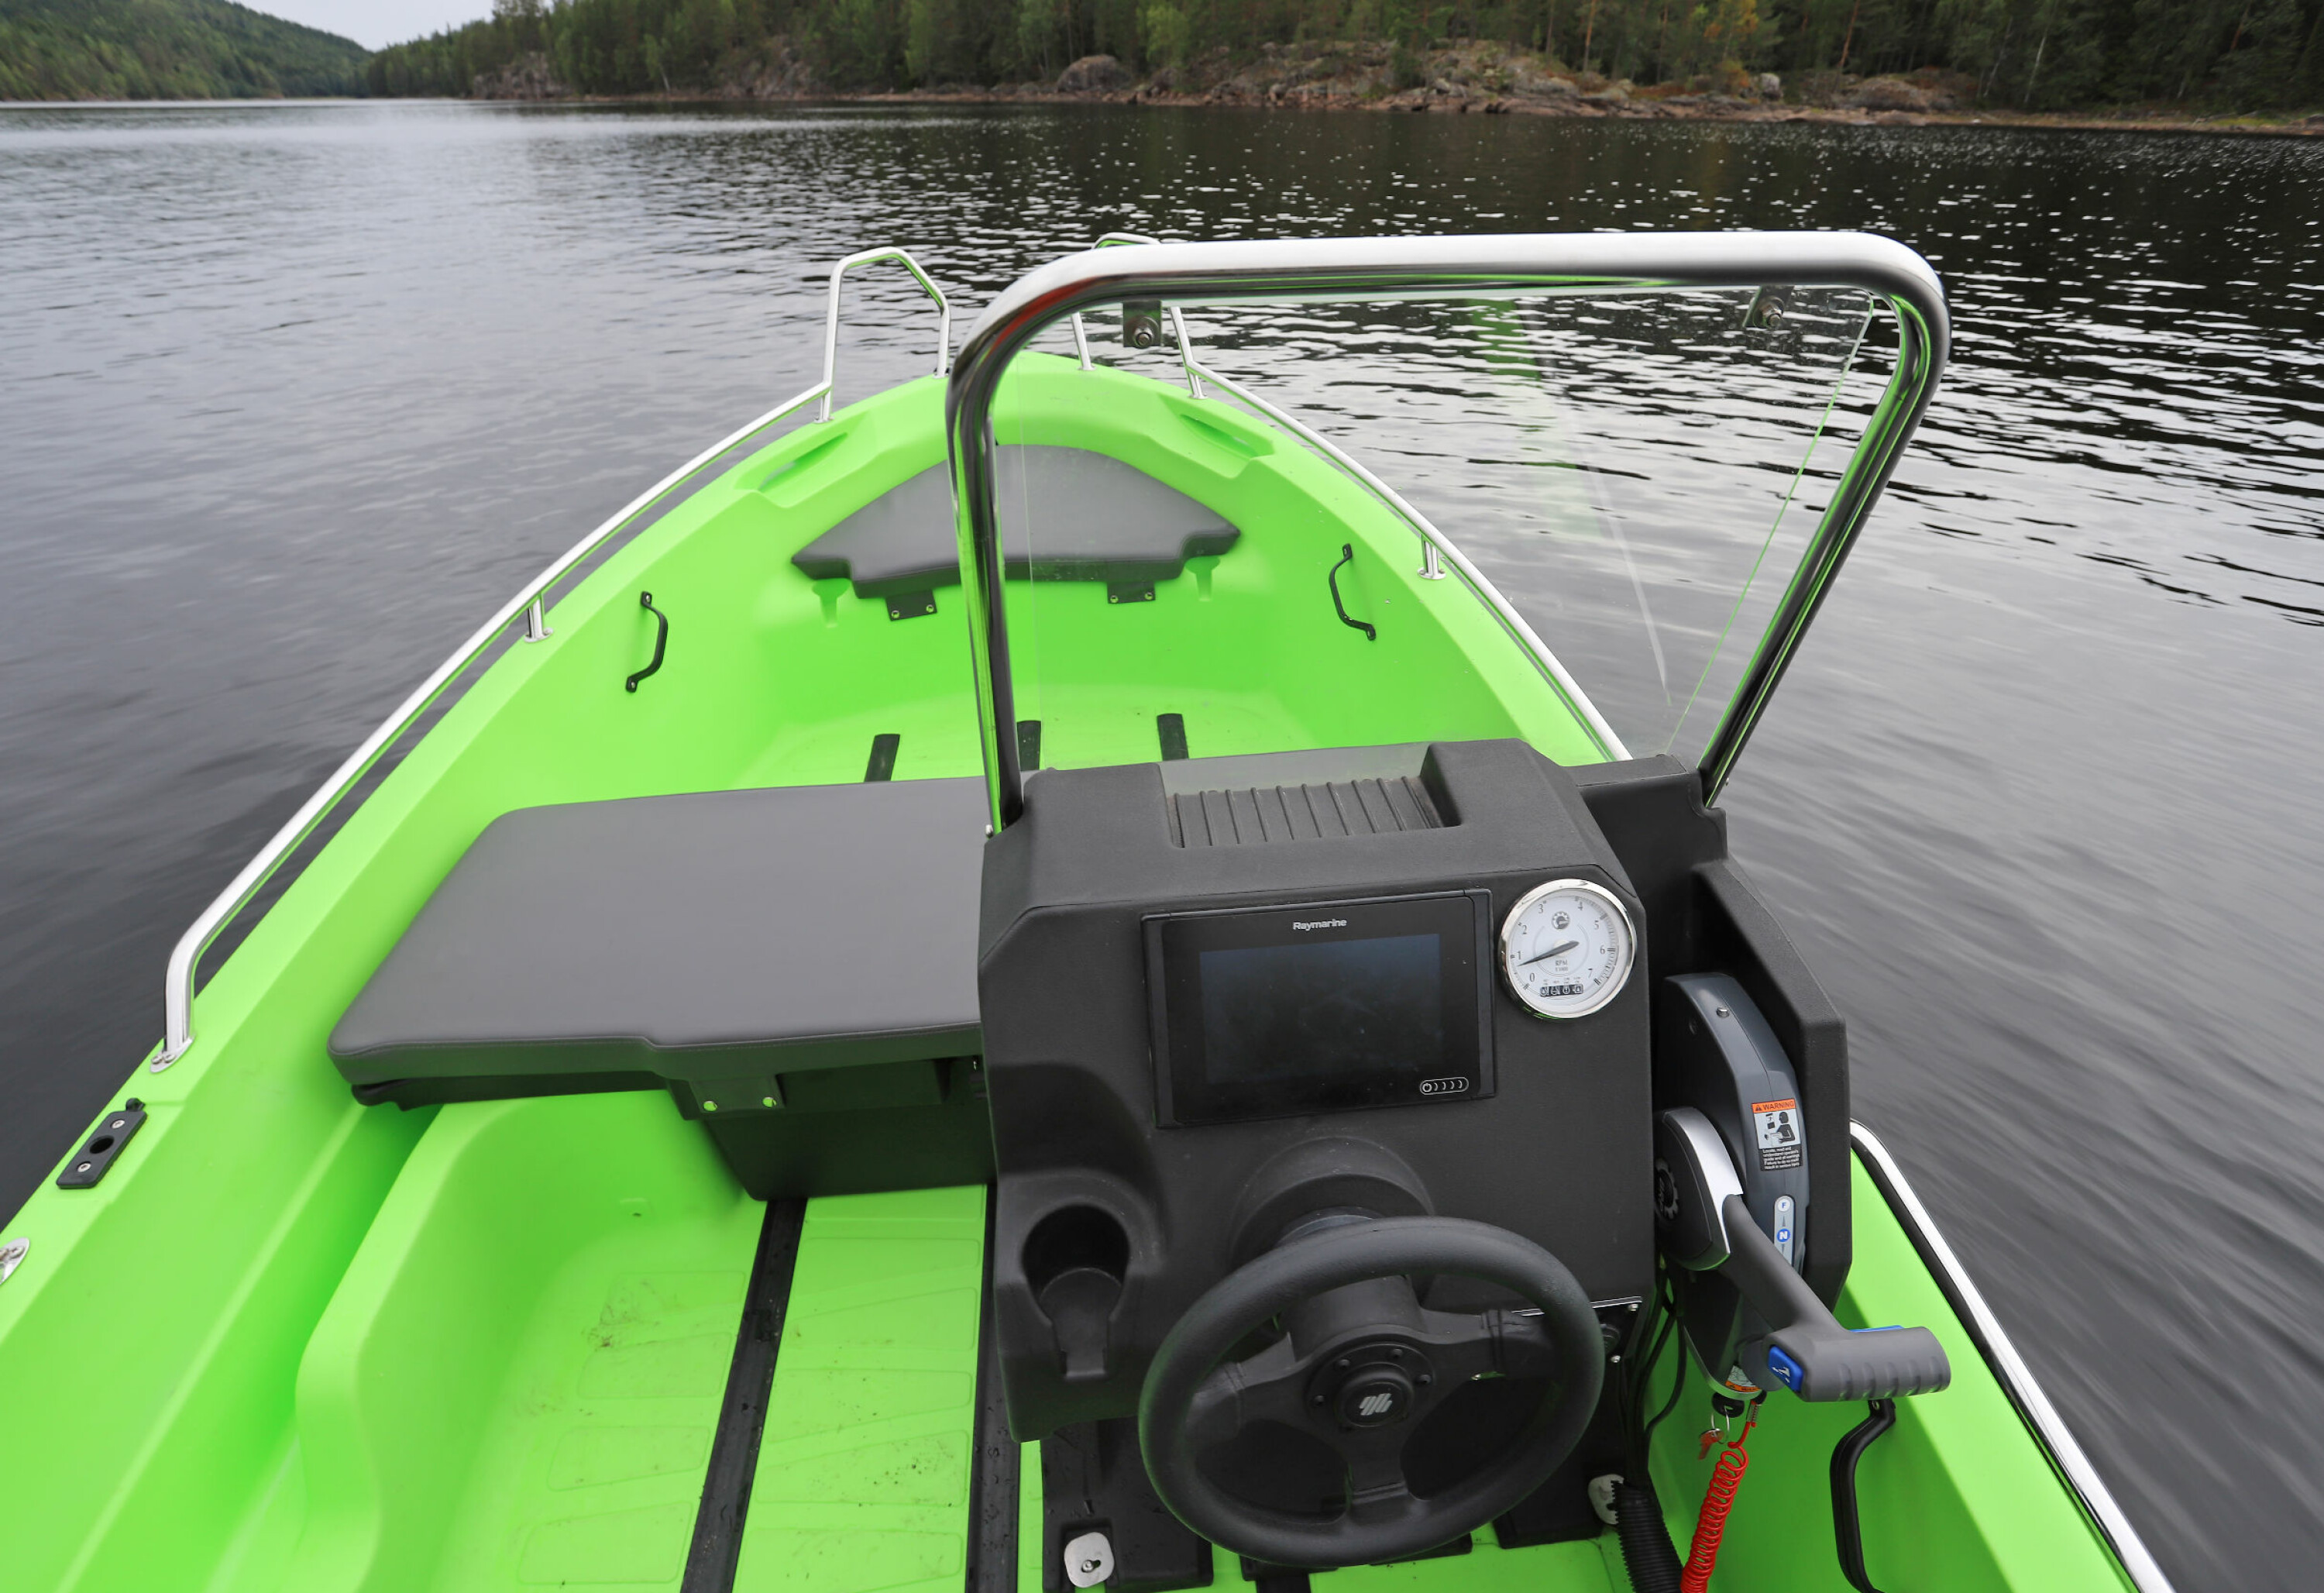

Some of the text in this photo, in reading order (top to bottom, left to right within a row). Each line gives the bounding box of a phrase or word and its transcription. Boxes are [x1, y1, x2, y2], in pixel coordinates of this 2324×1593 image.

[1538, 903, 1544, 913] 3
[1578, 901, 1583, 911] 4
[1293, 919, 1347, 931] Raymarine
[1522, 924, 1528, 934] 2
[1594, 920, 1600, 930] 5
[1600, 944, 1605, 955] 6
[1518, 950, 1521, 960] 1
[1529, 972, 1535, 982] 0
[1588, 968, 1593, 979] 7
[1763, 1101, 1795, 1110] WARNING
[1779, 1231, 1788, 1240] N
